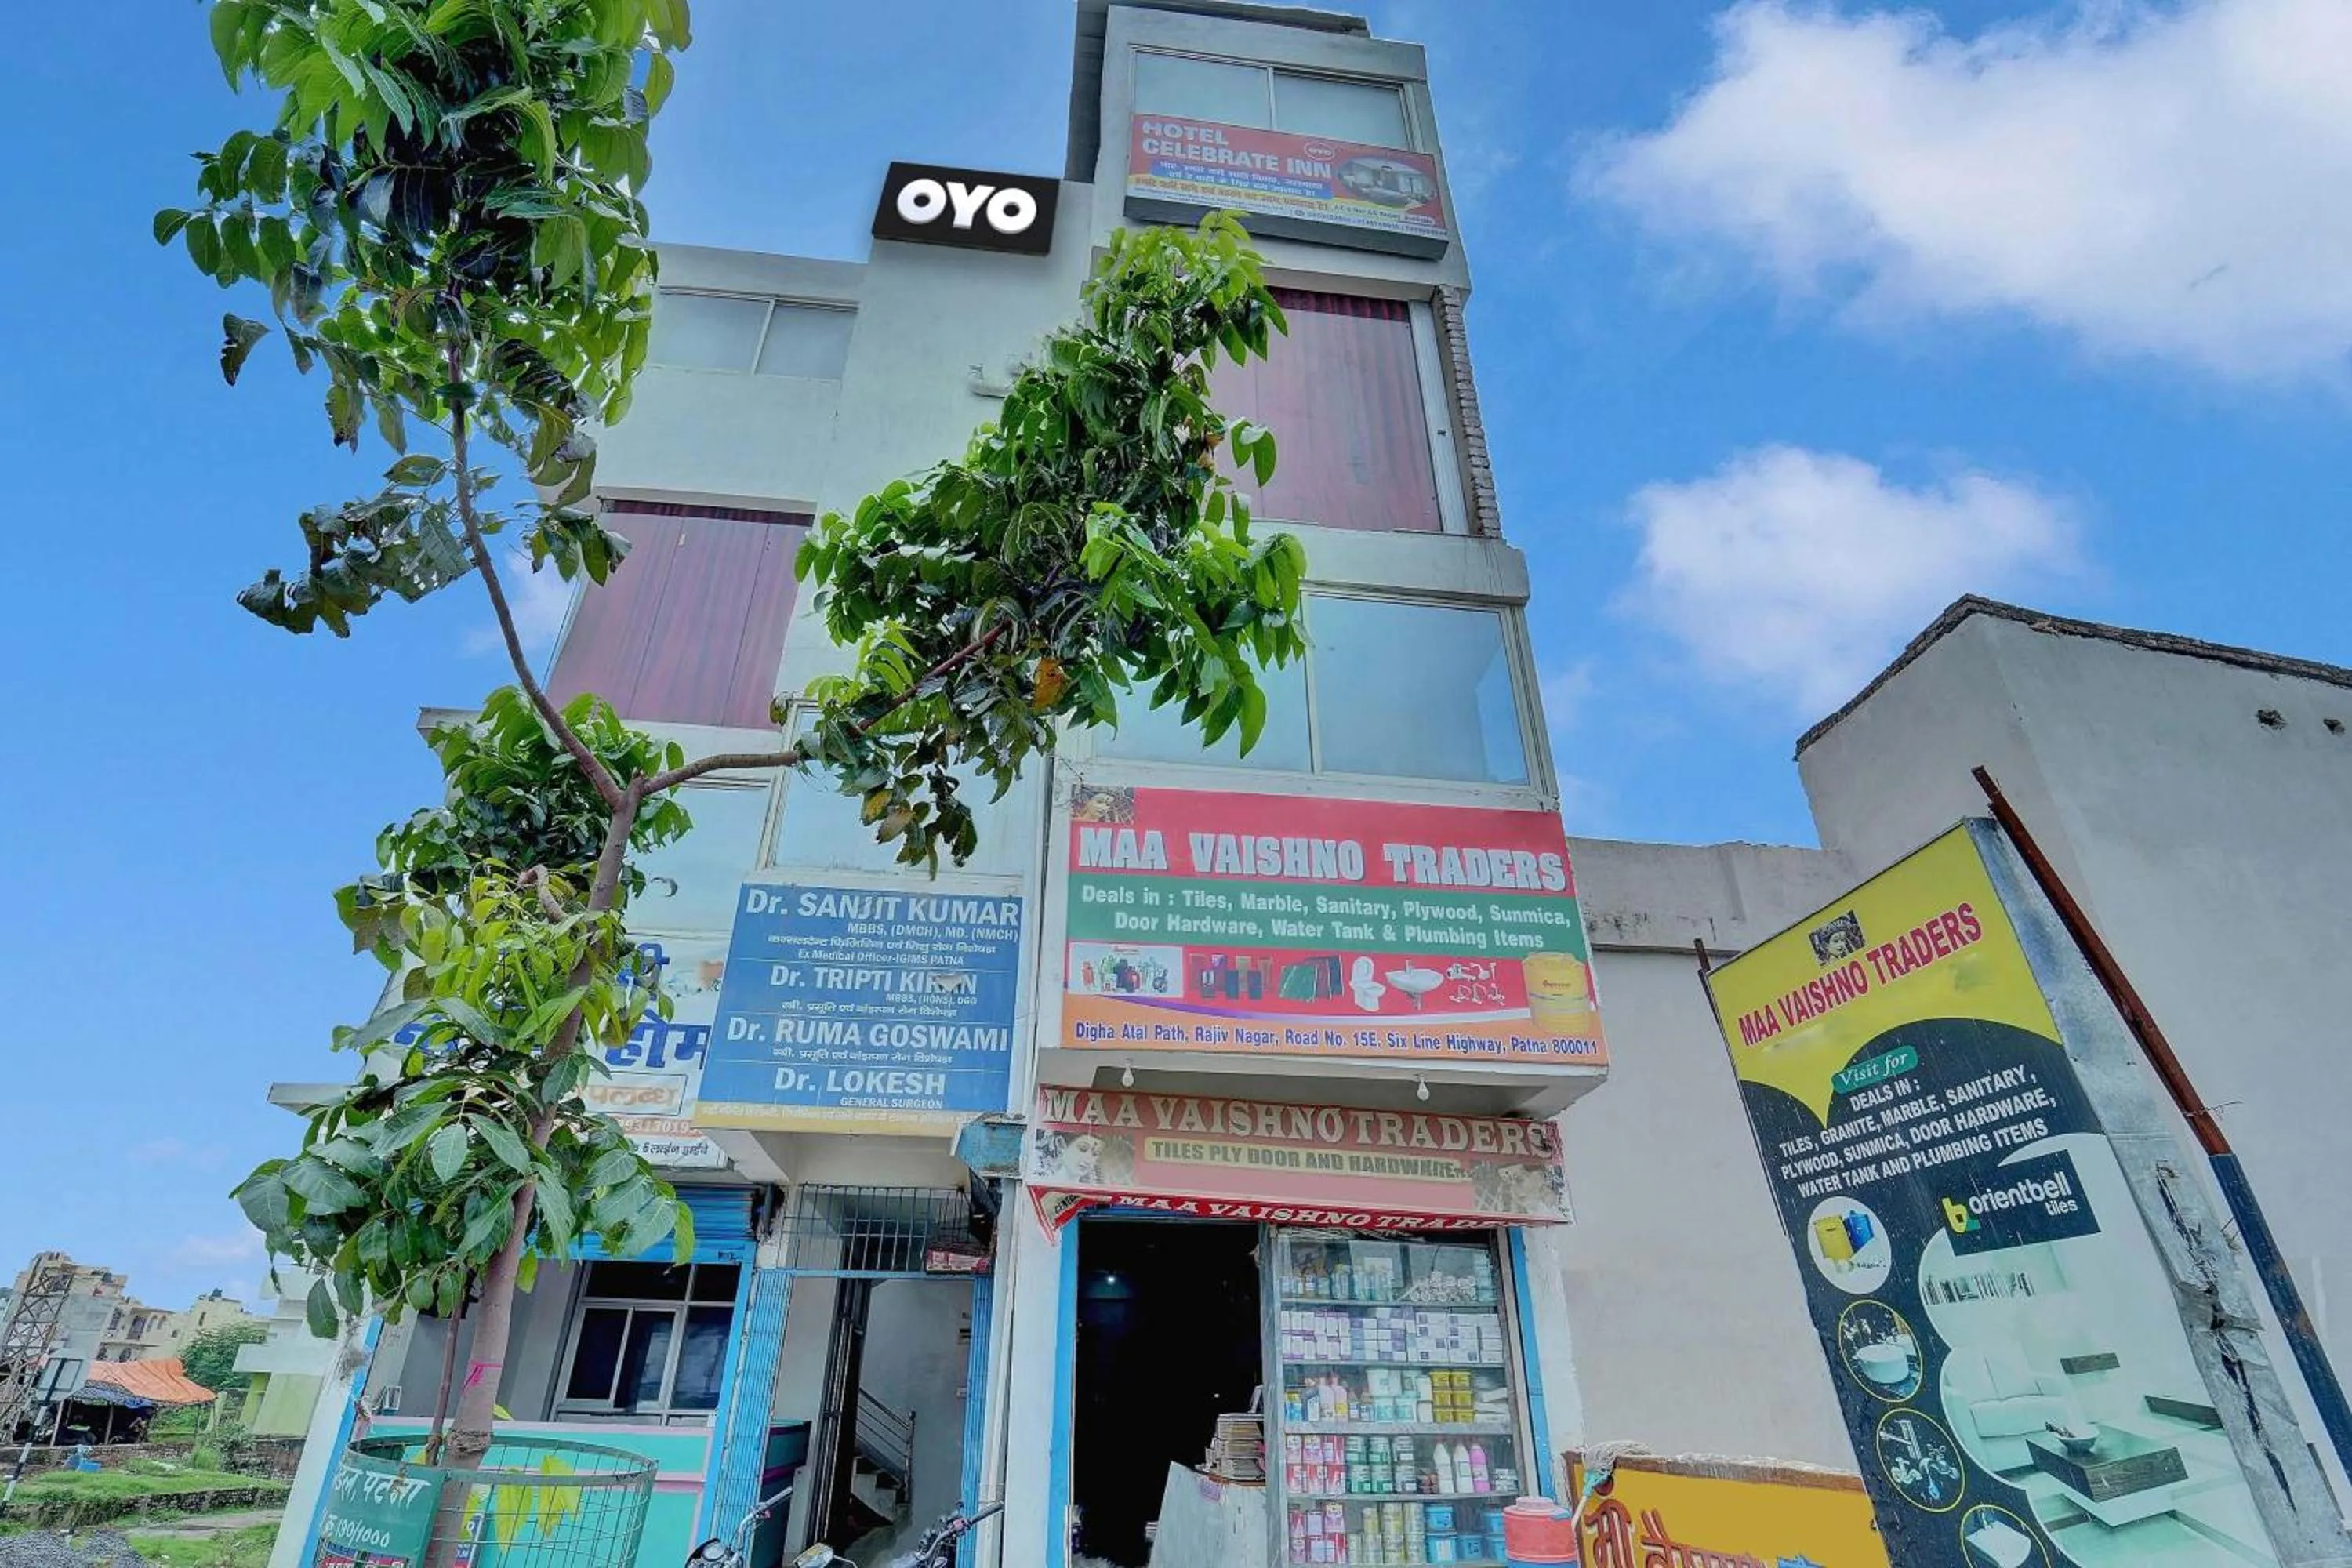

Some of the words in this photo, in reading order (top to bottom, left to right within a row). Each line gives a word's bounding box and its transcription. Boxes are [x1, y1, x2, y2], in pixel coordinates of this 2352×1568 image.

[1142, 121, 1229, 145] HOTEL
[1142, 138, 1279, 171] CELEBRATE
[1287, 158, 1332, 179] INN
[897, 178, 1037, 234] OYO
[1078, 827, 1168, 870] MAA
[1189, 832, 1364, 880] VAISHNO
[1383, 844, 1566, 891] TRADERS
[746, 889, 787, 915] Dr.
[797, 892, 902, 921] SANJIT
[907, 898, 1018, 926] KUMAR
[1082, 885, 1134, 904] Deals
[1143, 887, 1160, 905] in
[1182, 890, 1233, 911] Tiles,
[1241, 893, 1308, 916] Marble,
[1316, 896, 1396, 920] Sanitary,
[1403, 901, 1483, 923] Plywood,
[1490, 906, 1571, 927] Sunmica,
[971, 927, 1018, 942] (NMCH)
[1114, 912, 1159, 931] Door
[1167, 915, 1263, 938] Hardware,
[1272, 919, 1323, 938] Water
[1331, 921, 1374, 940] Tank
[1383, 925, 1396, 941] &
[1404, 925, 1486, 949] Plumbing
[1494, 930, 1544, 948] Items
[812, 950, 854, 960] Medical
[931, 956, 964, 966] PATNA
[1737, 1004, 1782, 1047] MAA
[1777, 960, 1869, 1027] VAISHNO
[1866, 902, 1982, 985] TRADERS
[771, 965, 805, 987] Dr.
[814, 967, 892, 992] TRIPTI
[900, 971, 977, 995] KIRN
[727, 1017, 765, 1042] Dr.
[775, 1019, 862, 1046] RUMA
[869, 1023, 1007, 1051] GOSWAMI
[1076, 1022, 1114, 1041] Digha
[1122, 1025, 1147, 1040] Atal
[1196, 1025, 1229, 1044] Rajiv
[1235, 1028, 1279, 1047] Nagar,
[1285, 1029, 1318, 1045] Road
[1325, 1030, 1346, 1047] No.
[1387, 1033, 1407, 1049] Six
[1414, 1034, 1441, 1050] Line
[1446, 1034, 1506, 1054] Highway,
[1511, 1036, 1547, 1053] Patna
[1552, 1038, 1598, 1054] 800011
[775, 1067, 815, 1091] Dr.
[826, 1070, 946, 1096] LOKESH
[1839, 1064, 1879, 1086] Visit
[1883, 1053, 1907, 1076] for
[840, 1097, 888, 1108] GENERAL
[892, 1098, 943, 1110] SURGEON
[1850, 1084, 1893, 1112] DEALS
[1894, 1078, 1912, 1097] IN
[1043, 1089, 1144, 1128] MAA
[1149, 1097, 1343, 1142] VAISHNO
[1349, 1111, 1553, 1159] TRADERS
[1779, 1136, 1820, 1157] TILES,
[1820, 1115, 1882, 1146] GRANITE,
[1880, 1094, 1947, 1127] MARBLE,
[1781, 1152, 1843, 1180] PLYWOOD,
[1843, 1133, 1911, 1163] SUNMICA,
[1910, 1118, 1953, 1145] DOOR
[1955, 1088, 2056, 1131] HARDWARE,
[1152, 1141, 1203, 1160] TILES
[1210, 1145, 1243, 1162] PLY
[1247, 1149, 1300, 1167] DOOR
[1306, 1152, 1342, 1170] AND
[1798, 1174, 1842, 1199] WATER
[1842, 1164, 1880, 1187] TANK
[1882, 1156, 1911, 1178] AND
[1911, 1133, 1993, 1170] PLUMBING
[1993, 1118, 2049, 1148] ITEMS
[1969, 1171, 2072, 1214] orientbell
[2045, 1199, 2078, 1216] tiles
[1119, 1196, 1198, 1213] MAA
[1209, 1203, 1371, 1227] VAISHNO
